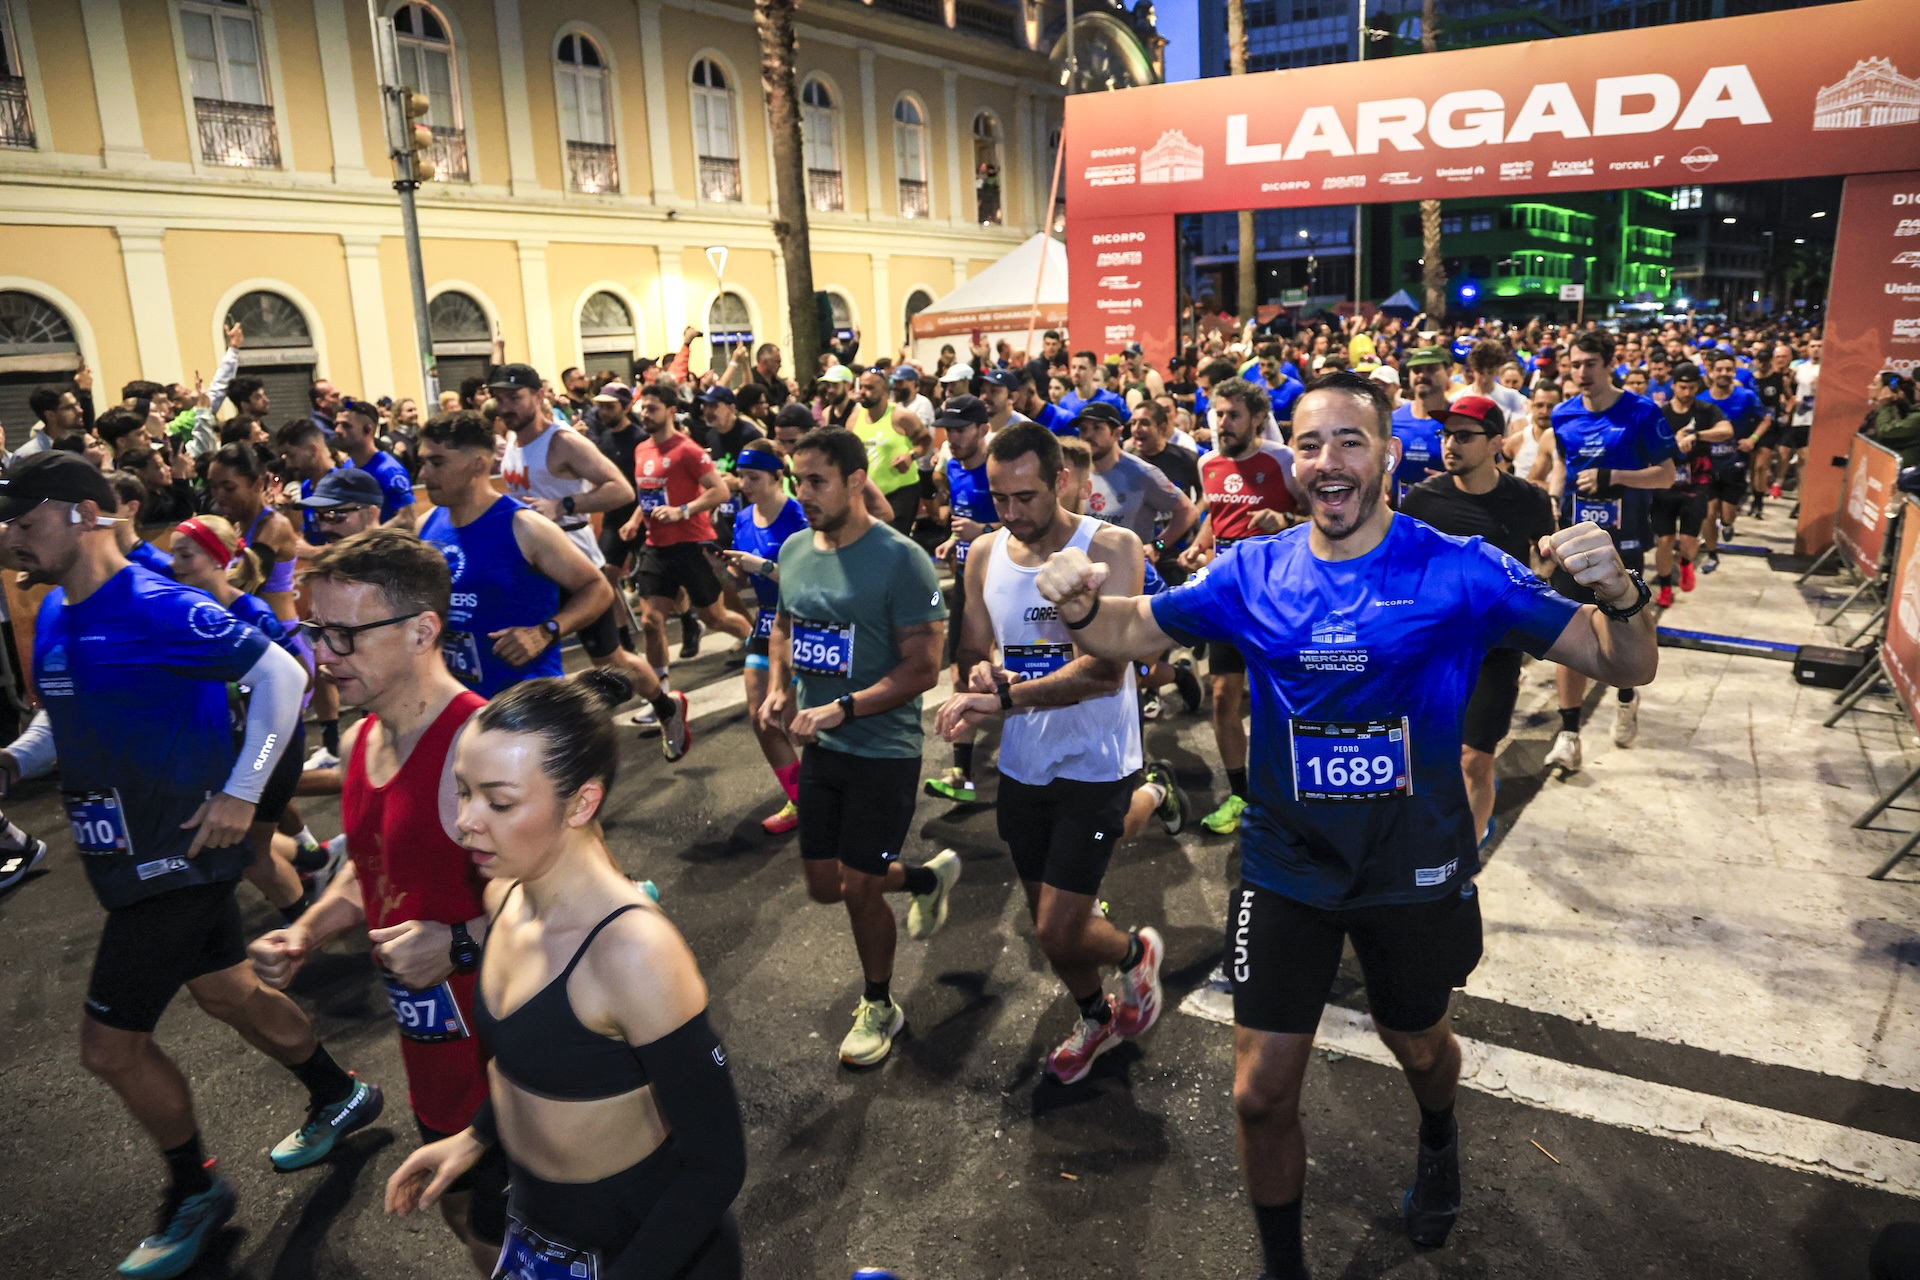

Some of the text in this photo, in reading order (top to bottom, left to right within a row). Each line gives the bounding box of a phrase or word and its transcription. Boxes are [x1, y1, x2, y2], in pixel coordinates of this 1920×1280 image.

[1226, 64, 1772, 165] LARGADA
[1091, 146, 1136, 159] DICORPO
[1261, 180, 1310, 192] DICORPO
[1092, 231, 1145, 245] DICORPO
[1581, 510, 1609, 524] 909
[794, 639, 840, 667] 2596
[1299, 655, 1368, 663] MERCADO
[1307, 756, 1394, 787] 1689
[1446, 861, 1458, 876] 21
